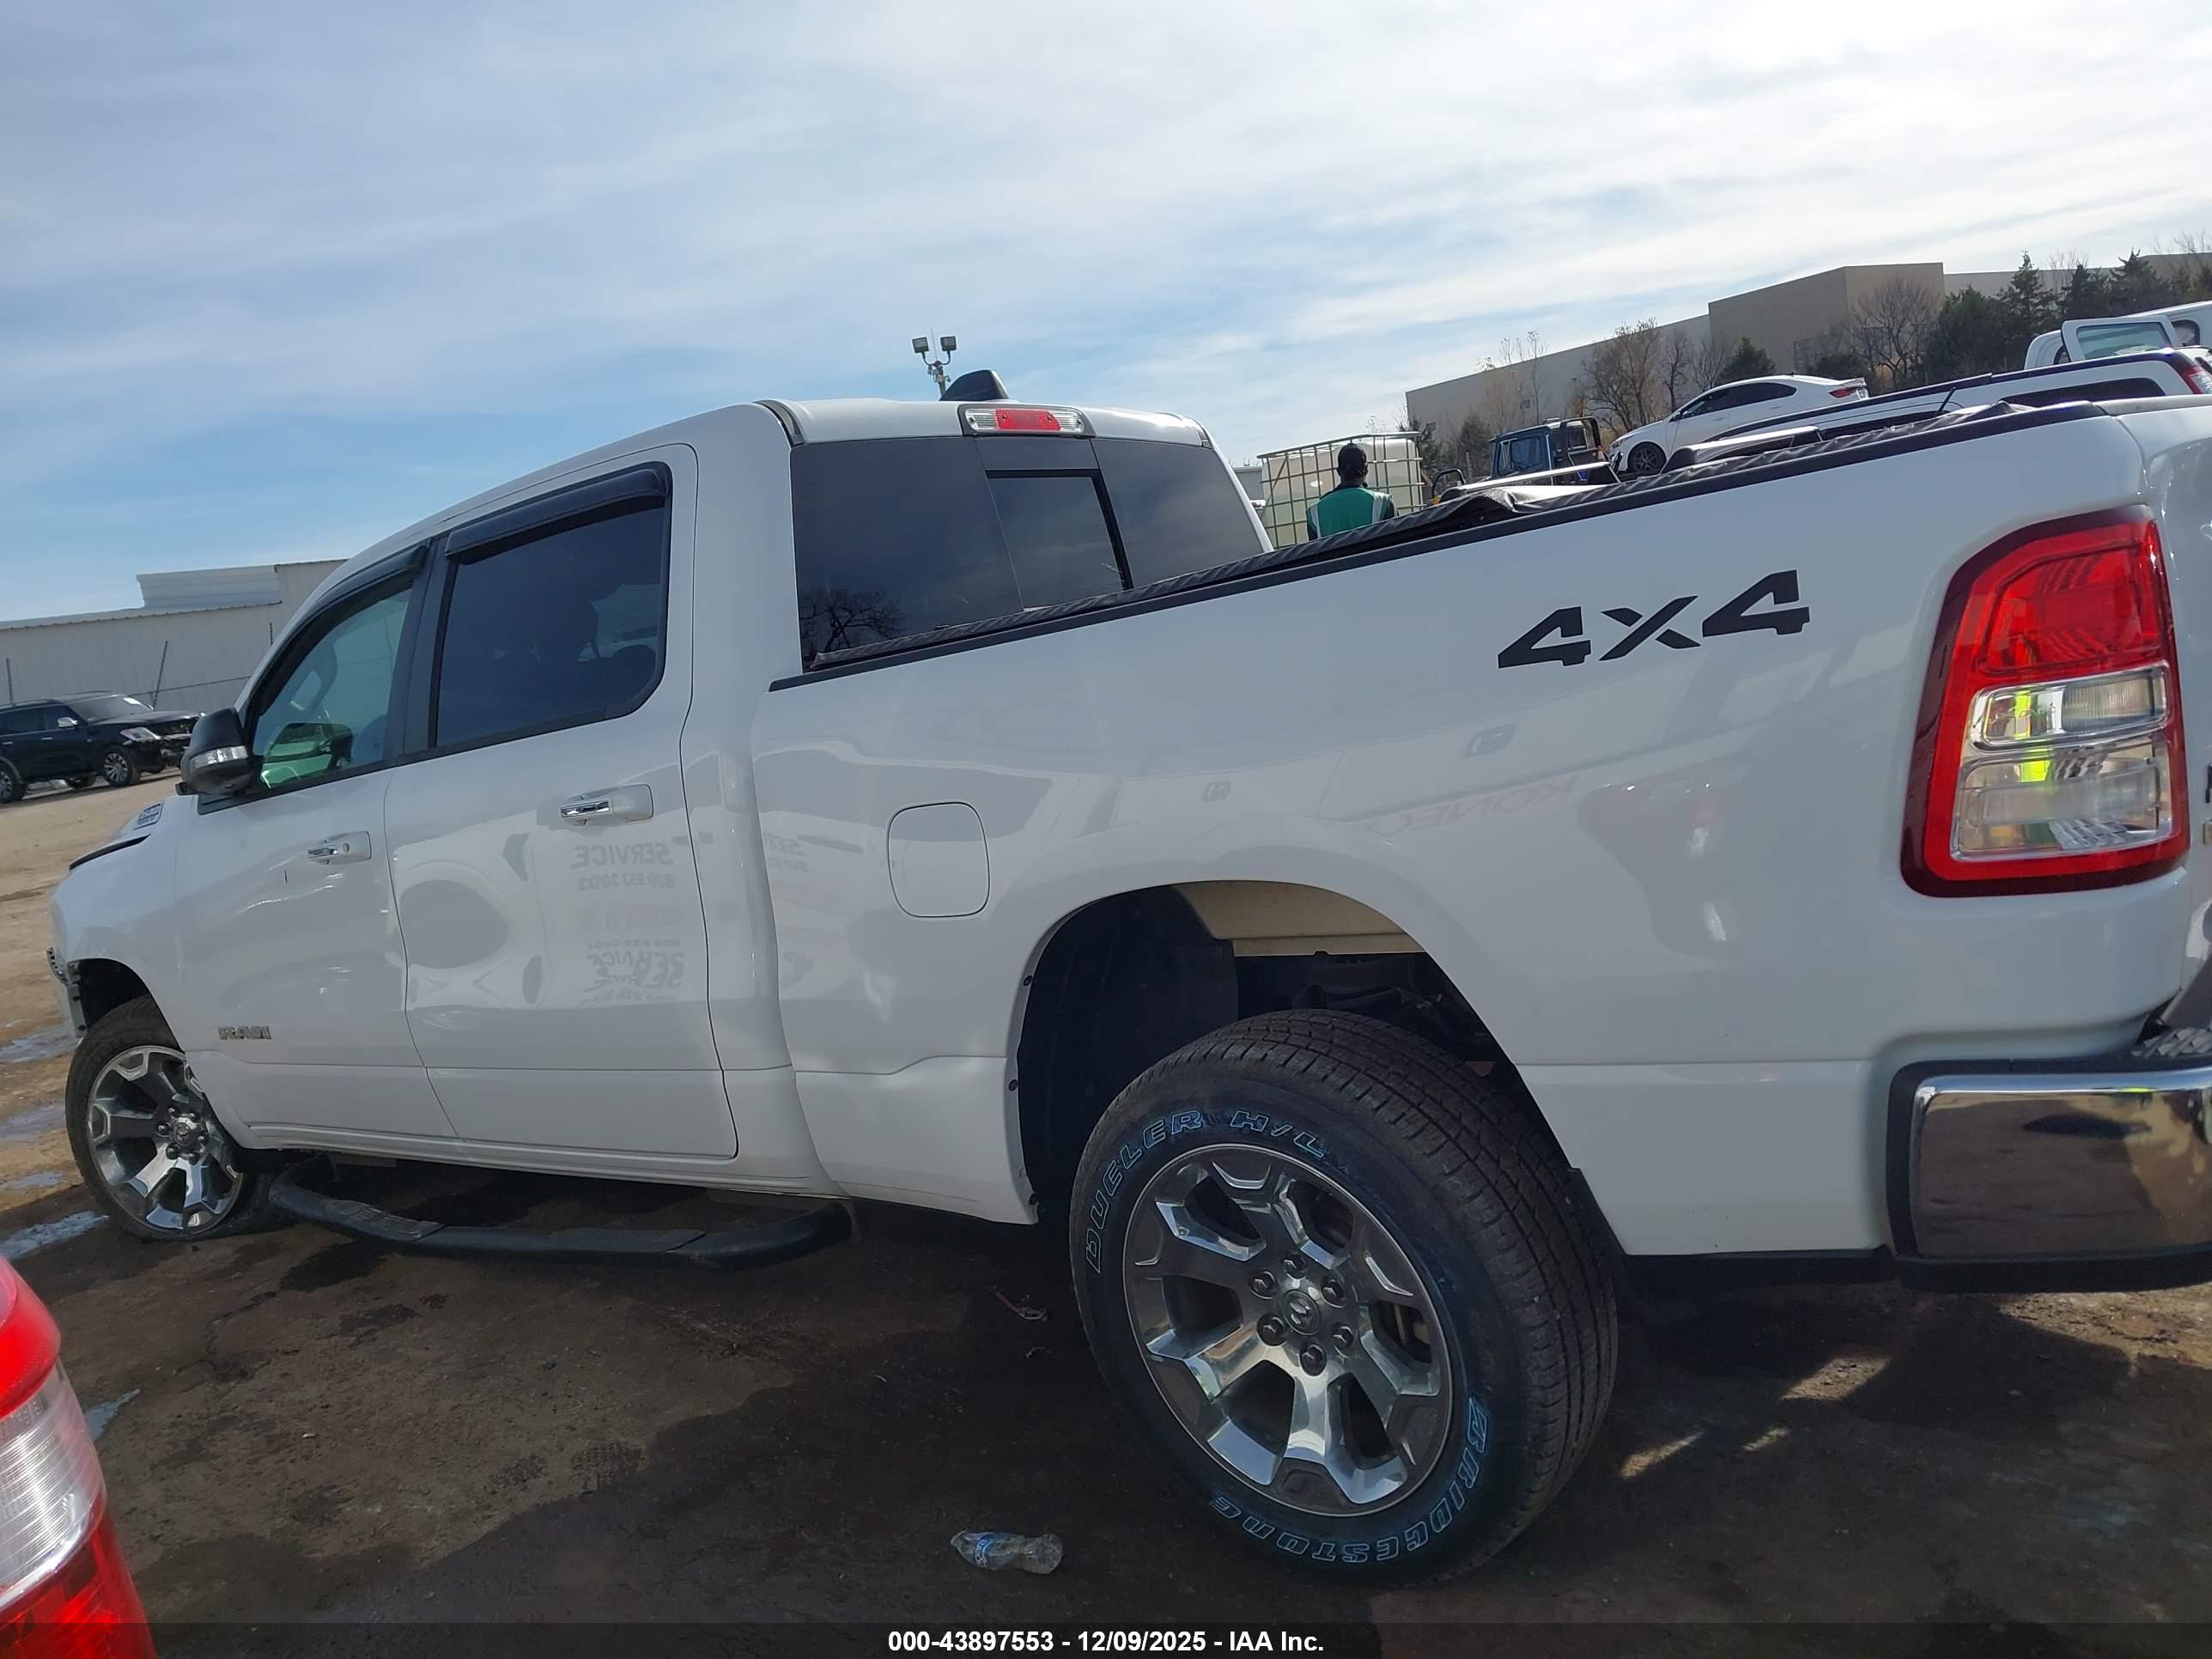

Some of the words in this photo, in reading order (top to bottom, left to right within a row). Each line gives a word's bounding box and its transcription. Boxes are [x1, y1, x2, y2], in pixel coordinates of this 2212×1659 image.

[218, 1025, 272, 1040] RAM
[1085, 1109, 1202, 1274] DUELER
[1230, 1110, 1325, 1158] H/L
[1209, 1397, 1488, 1563] BRIDGESTONE
